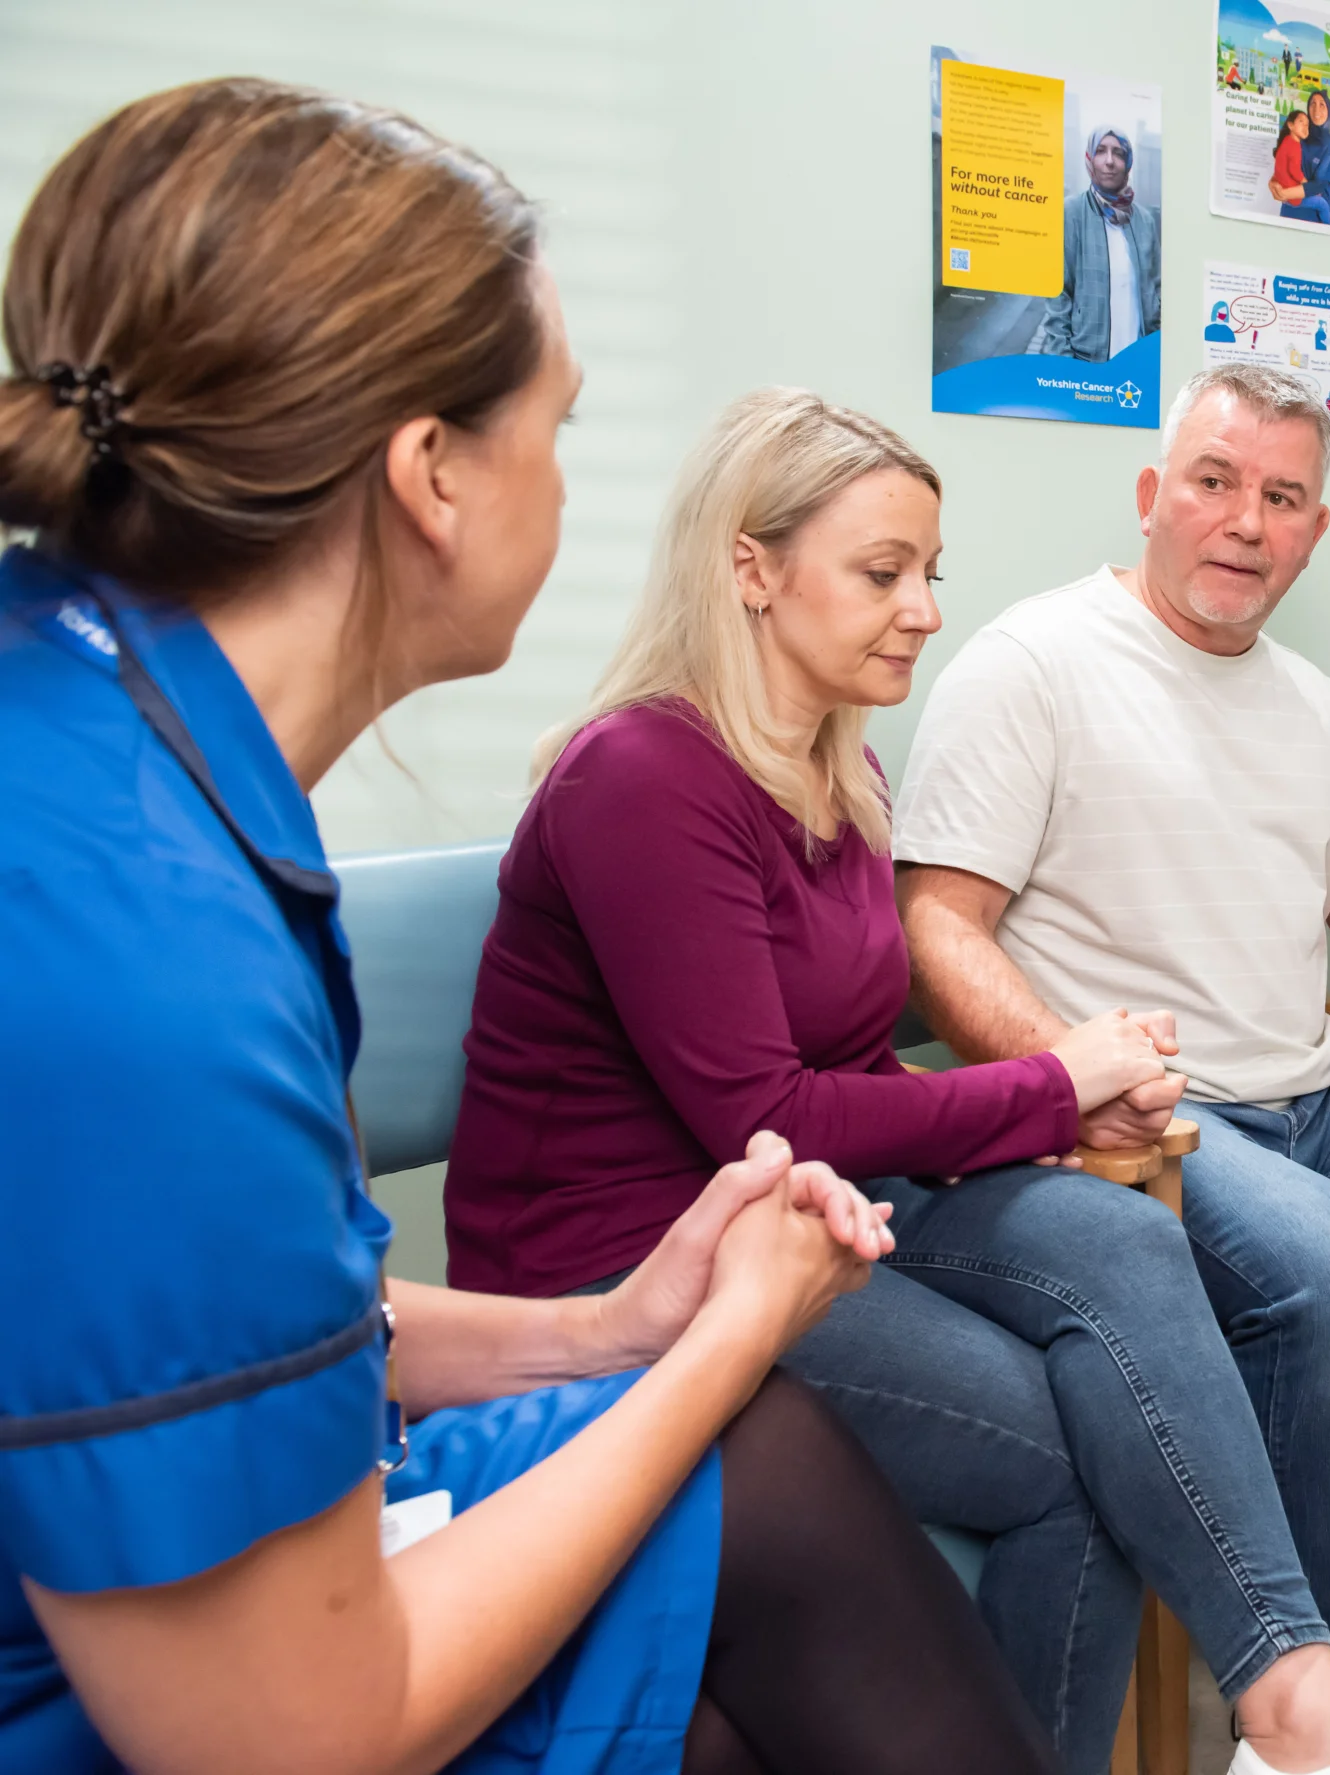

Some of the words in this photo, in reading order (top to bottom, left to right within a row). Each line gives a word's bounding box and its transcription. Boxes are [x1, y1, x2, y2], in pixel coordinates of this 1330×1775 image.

[1226, 92, 1248, 103] Caring
[1226, 106, 1247, 114] planet
[1256, 112, 1277, 122] caring
[1249, 124, 1277, 134] patients
[951, 166, 972, 180] For
[976, 173, 1010, 186] more
[1014, 176, 1034, 189] life
[951, 182, 1000, 198] without
[1004, 190, 1048, 204] cancer
[951, 205, 978, 216] Thank
[981, 211, 997, 219] you
[1279, 280, 1297, 291] Keeping
[1036, 377, 1080, 389] Yorkshire
[1082, 382, 1114, 392] Cancer
[1075, 391, 1113, 402] Research
